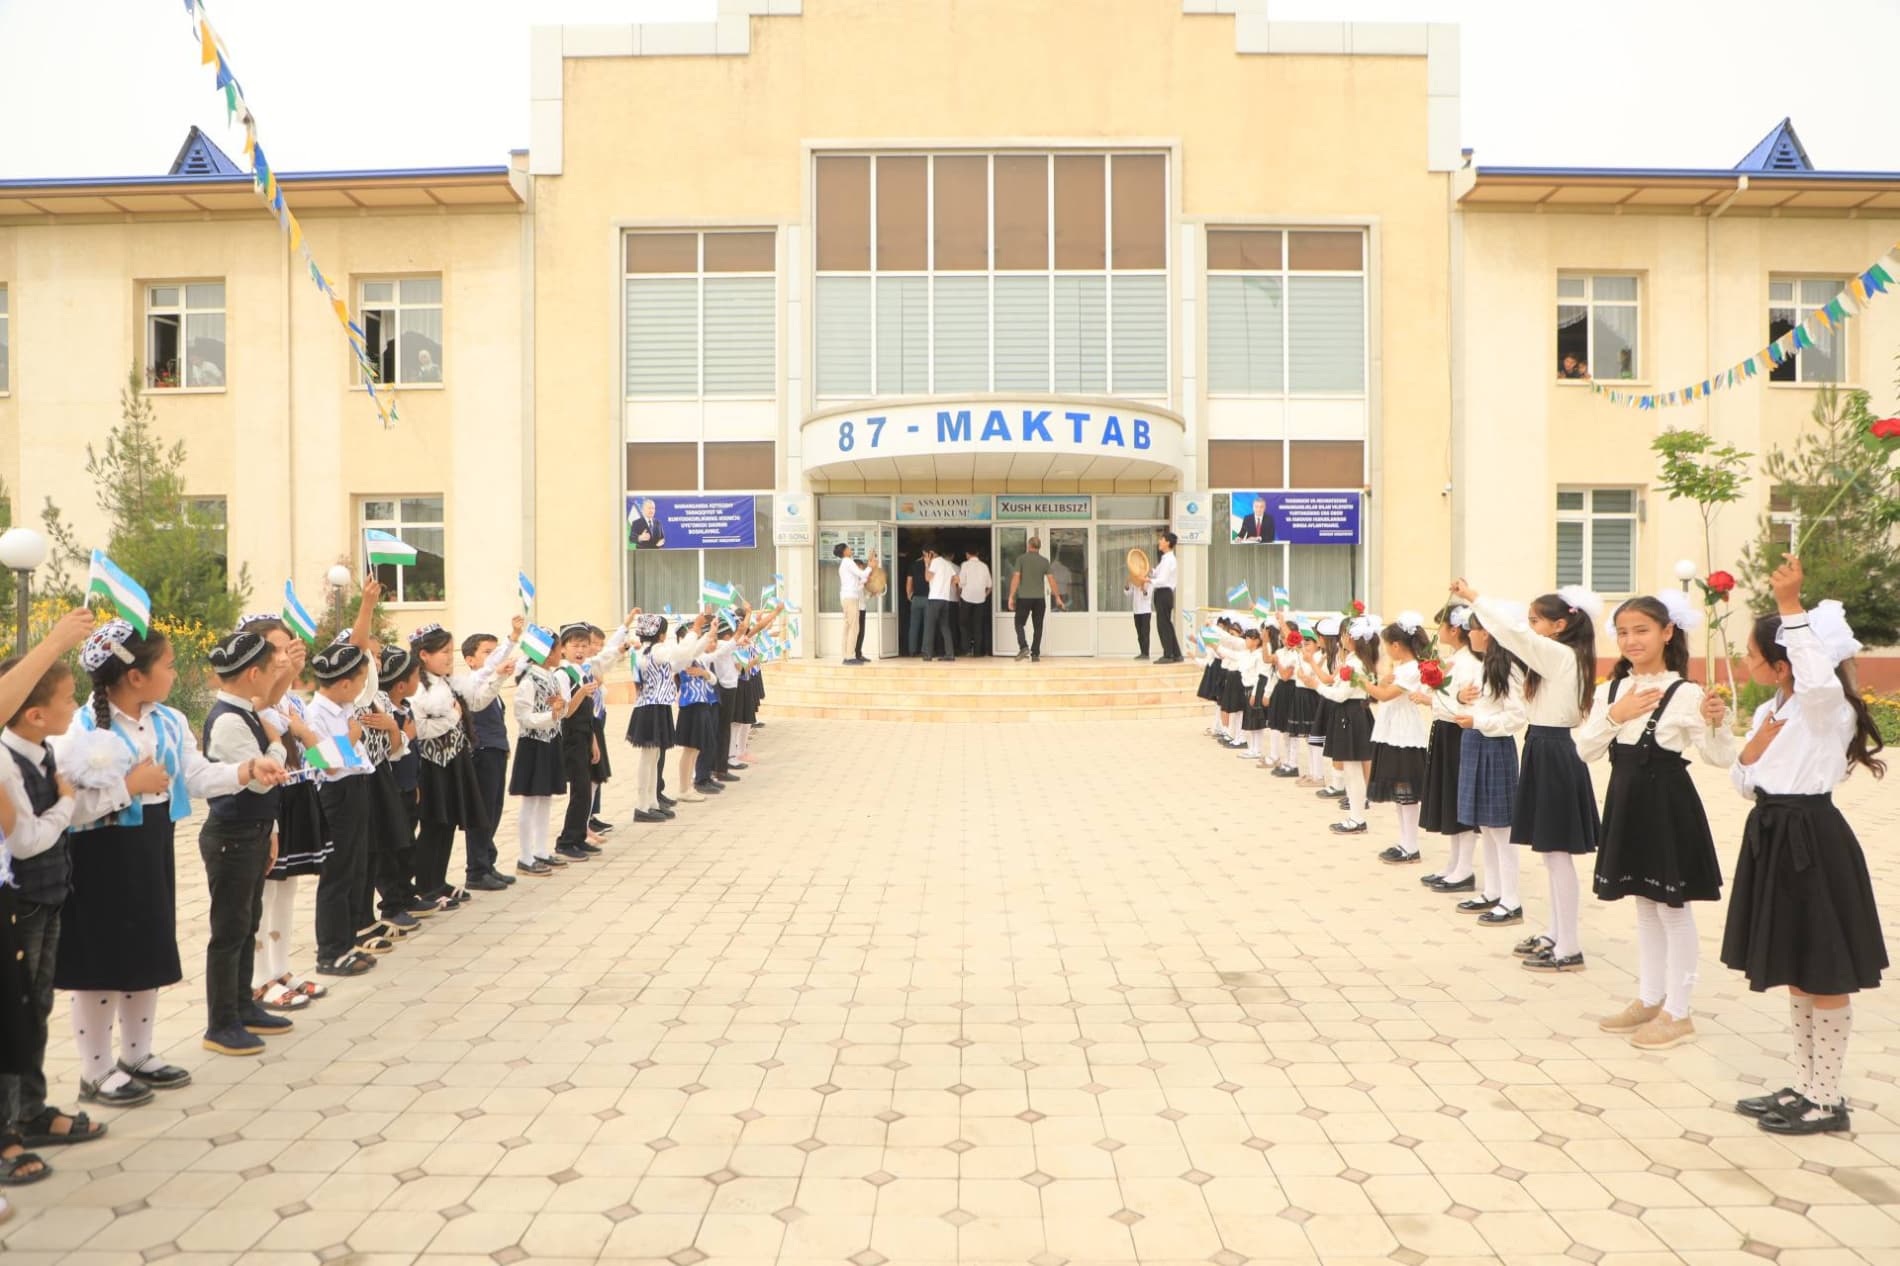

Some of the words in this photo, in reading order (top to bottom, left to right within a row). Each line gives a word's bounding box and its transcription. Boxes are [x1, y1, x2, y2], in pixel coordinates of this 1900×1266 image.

[838, 416, 887, 452] 87
[936, 410, 1152, 450] MAKTAB
[1001, 502, 1030, 513] XUSH
[1035, 502, 1088, 513] KELIBSIZ!
